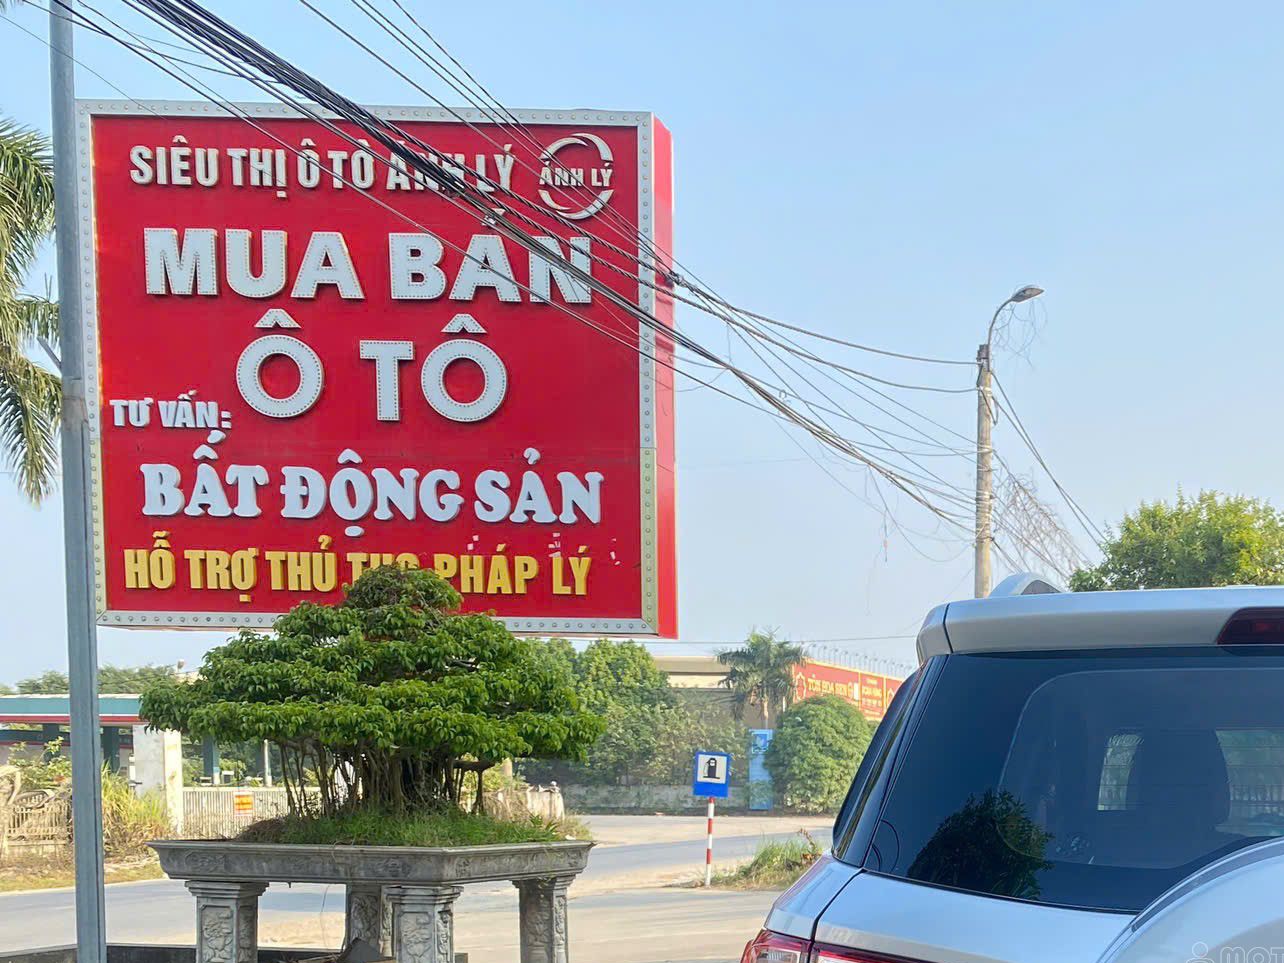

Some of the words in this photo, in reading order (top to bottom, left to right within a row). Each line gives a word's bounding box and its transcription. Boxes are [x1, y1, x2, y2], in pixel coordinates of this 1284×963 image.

[130, 135, 219, 187] SIÊU
[227, 147, 288, 198] THỊ
[297, 138, 321, 190] Ô
[328, 138, 377, 190] TÔ
[475, 143, 516, 193] LÝ
[538, 160, 584, 187] ÁNH
[591, 162, 614, 187] LÝ
[143, 227, 366, 299] MUA
[388, 207, 593, 304] BÁN
[235, 308, 325, 419] Ô
[359, 313, 509, 424] TÔ
[109, 397, 154, 428] TƯ
[158, 389, 232, 430] VẤN:
[139, 429, 270, 518] BẤT
[279, 448, 466, 537] ĐỘNG
[474, 447, 605, 525] SẢN
[123, 530, 177, 590] HỖ
[183, 547, 259, 603] TRỢ
[264, 534, 337, 593] THỦ
[433, 543, 540, 595] PHÁP
[552, 545, 593, 596] LÝ
